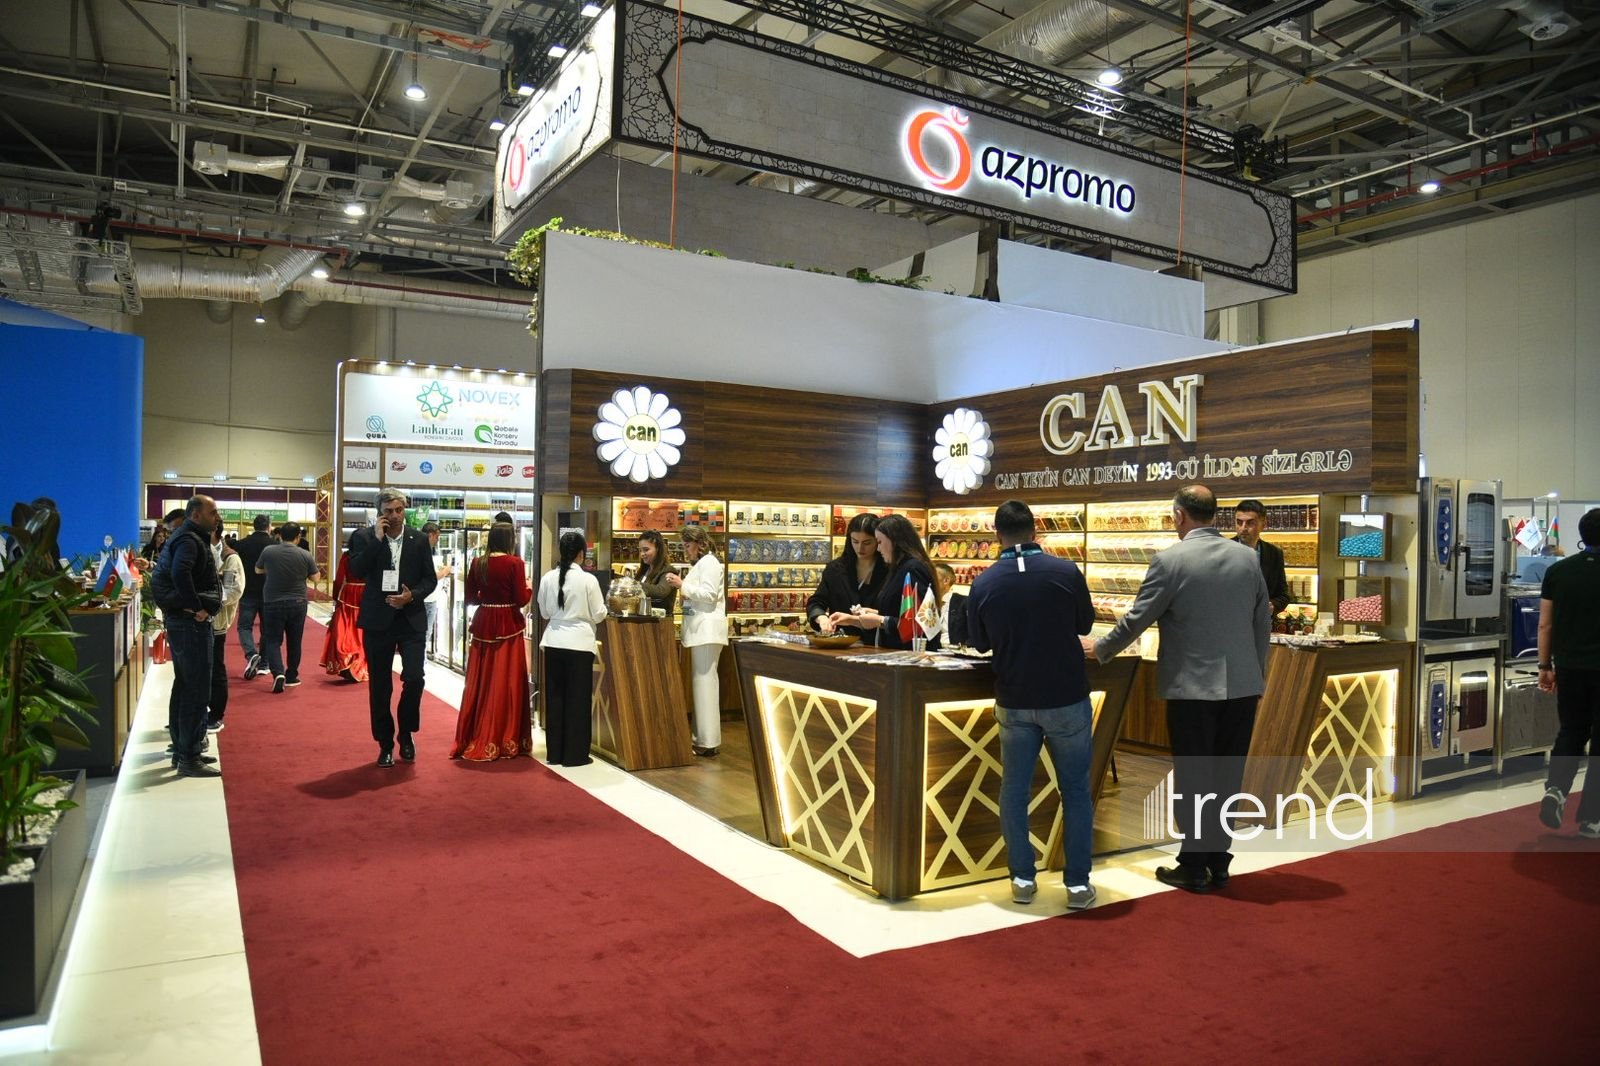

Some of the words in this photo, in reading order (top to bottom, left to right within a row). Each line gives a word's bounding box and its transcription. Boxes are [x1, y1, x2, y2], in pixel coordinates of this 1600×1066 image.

[526, 85, 582, 161] azpromo
[981, 145, 1136, 213] azpromo
[458, 388, 521, 407] NOVEX
[1040, 373, 1205, 456] CAN
[366, 432, 387, 440] QUBA
[625, 424, 657, 442] can
[949, 442, 969, 458] can
[994, 473, 1019, 491] CAN
[1020, 467, 1059, 489] YEYİN
[1062, 467, 1091, 487] CAN
[1093, 461, 1140, 485] DEYİN
